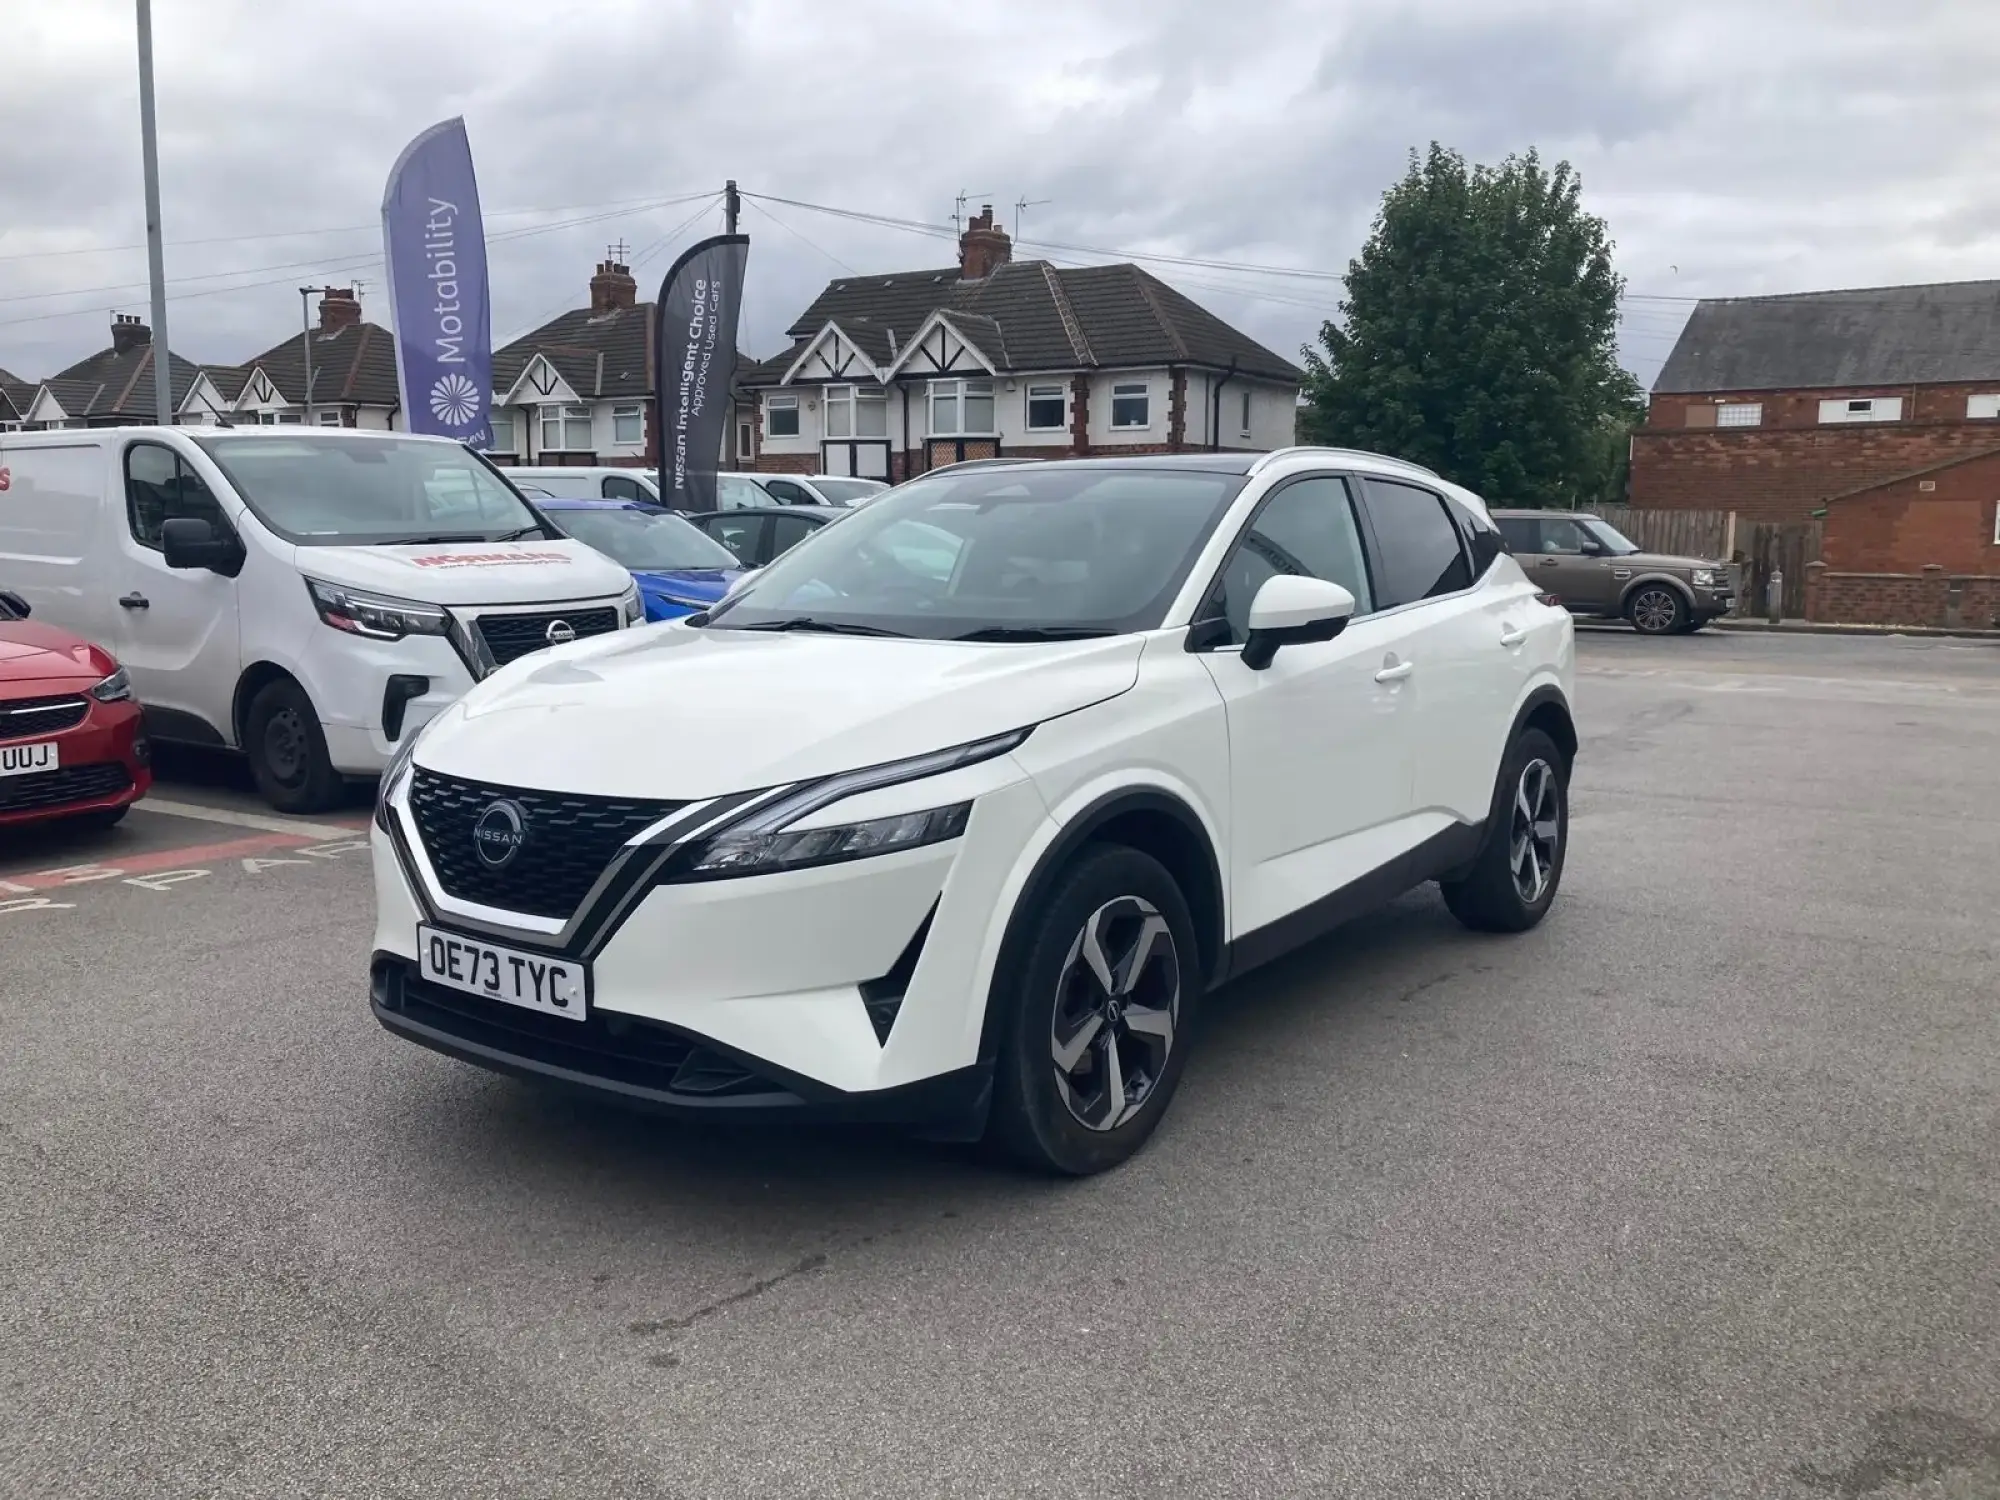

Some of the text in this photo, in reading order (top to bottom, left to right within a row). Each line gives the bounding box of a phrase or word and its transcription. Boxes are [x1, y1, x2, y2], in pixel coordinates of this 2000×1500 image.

[425, 197, 465, 362] Motability
[675, 280, 707, 490] Nissan Intelligent Choice
[691, 280, 721, 416] Approved Used Cars
[3, 745, 48, 770] UUJ
[473, 827, 522, 844] NISSAN
[430, 936, 568, 1007] OE73 TYC
